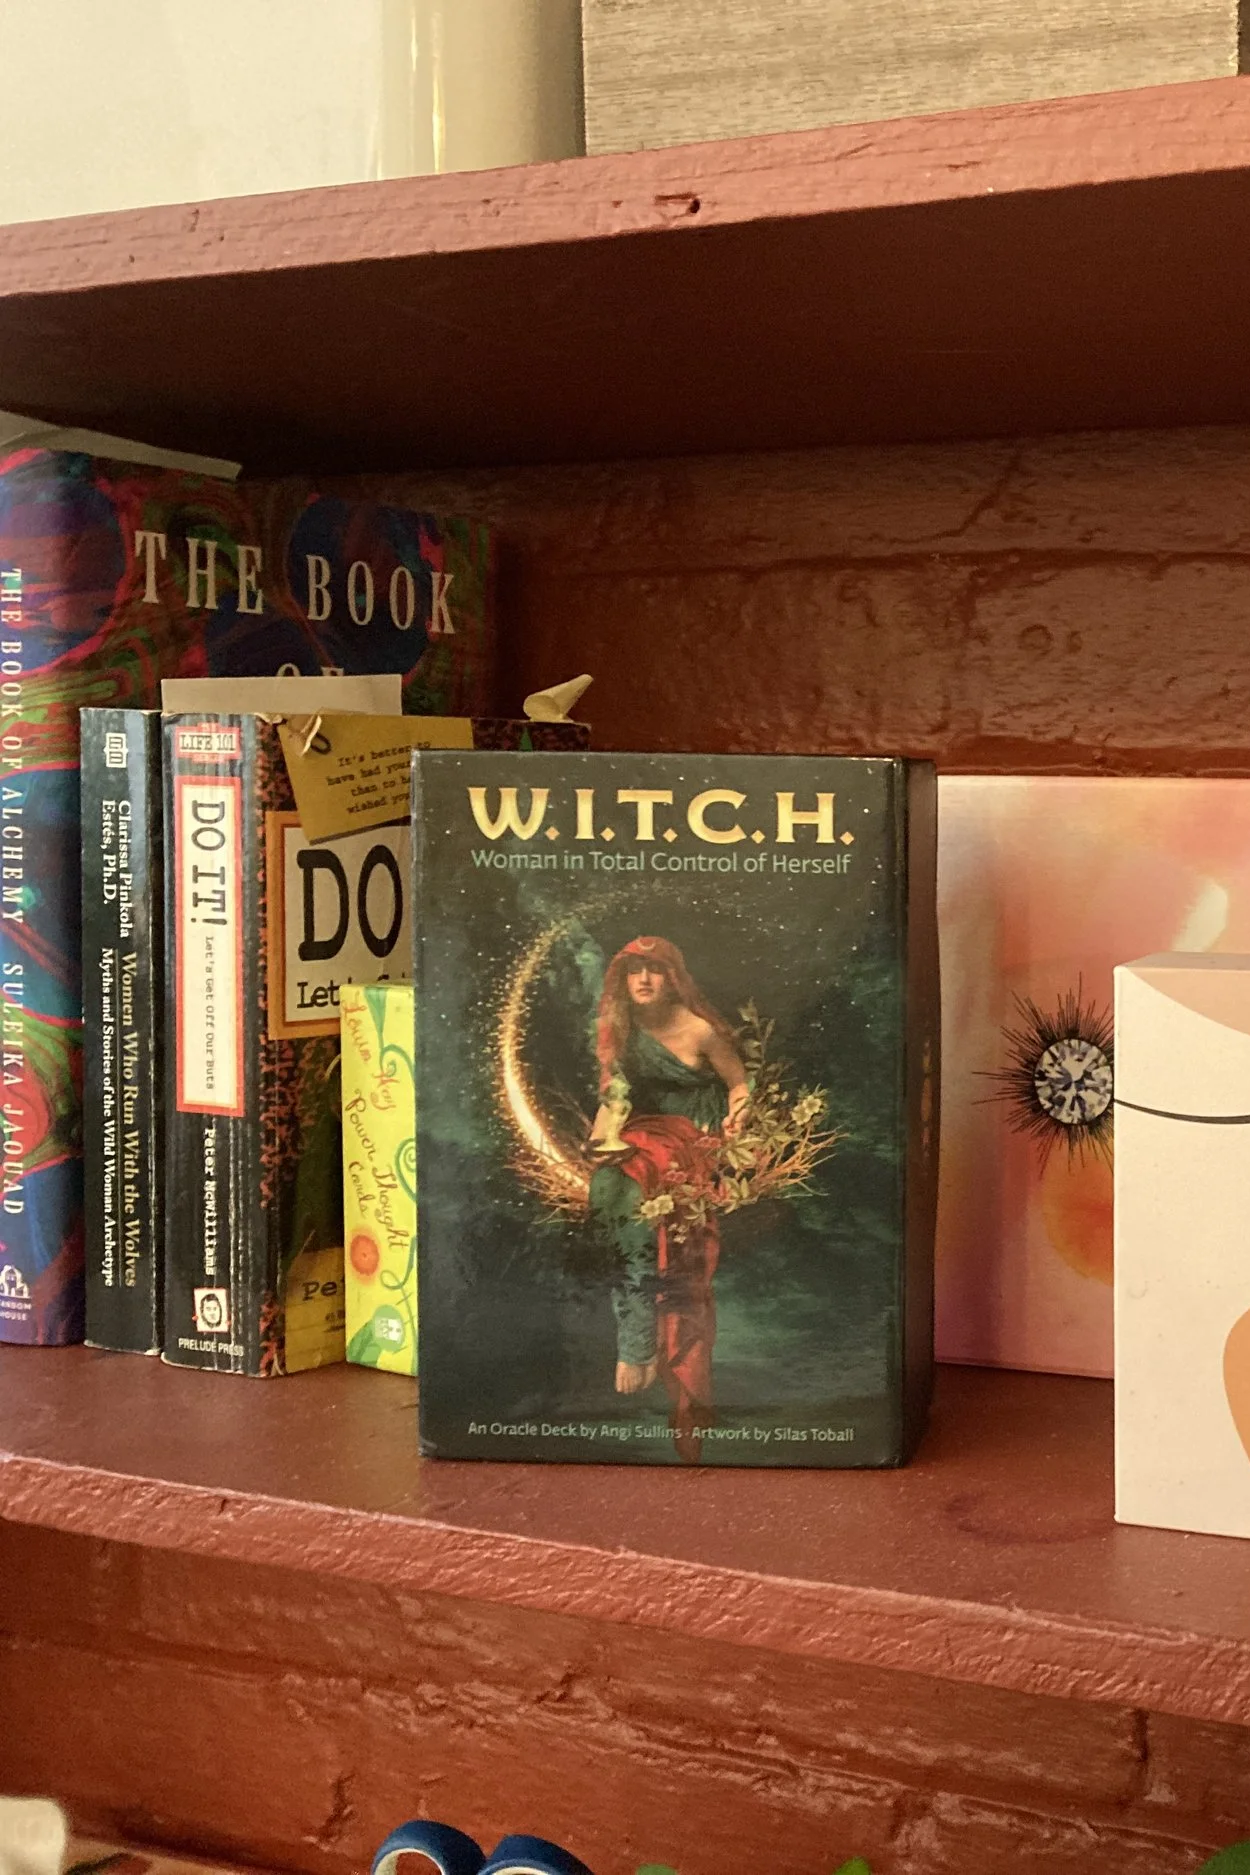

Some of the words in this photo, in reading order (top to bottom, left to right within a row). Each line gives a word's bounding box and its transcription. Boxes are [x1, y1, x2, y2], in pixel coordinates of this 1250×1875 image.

[1, 568, 22, 622] THE
[135, 530, 263, 615] THE
[305, 554, 456, 634] BOOK
[1, 640, 22, 717] BOOK
[1, 736, 22, 769] OF
[180, 734, 212, 750] LIFE
[217, 734, 236, 751] 101
[337, 755, 365, 767] It's
[370, 745, 411, 760] better
[326, 774, 355, 785] have
[360, 765, 381, 778] had
[351, 784, 377, 796] than
[383, 780, 395, 789] to
[100, 800, 116, 849] Estés,
[191, 799, 226, 851] DO
[347, 796, 388, 813] wished
[467, 786, 855, 845] W.I.T.C.H.
[1, 787, 24, 923] ALCHEMY
[118, 800, 133, 869] Clarissa
[103, 854, 117, 905] Ph.D.
[471, 849, 559, 870] Woman
[564, 850, 584, 870] in
[589, 850, 645, 871] Total
[651, 852, 737, 872] Control
[744, 852, 767, 873] of
[773, 854, 851, 874] Herself
[119, 872, 134, 938] Pinkola
[191, 865, 227, 926] IT!
[297, 845, 403, 961] DO
[98, 948, 114, 994] Myths
[205, 936, 214, 973] Let's
[102, 995, 114, 1022] and
[122, 952, 137, 1026] Women
[205, 977, 214, 1001] Get
[297, 977, 353, 1009] Let'
[2, 962, 24, 1086] SULEIKA
[206, 1007, 215, 1027] Off
[102, 1025, 114, 1075] Stories
[122, 1031, 138, 1080] Who
[206, 1032, 215, 1058] Our
[103, 1077, 114, 1093] of
[206, 1060, 215, 1090] Buts
[103, 1094, 114, 1117] the
[123, 1085, 138, 1125] Run
[3, 1102, 25, 1214] JAOUAD
[104, 1119, 116, 1156] Wild
[124, 1129, 140, 1180] With
[204, 1128, 216, 1175] Peter
[104, 1156, 116, 1215] Woman
[345, 1089, 376, 1162] Power
[372, 1164, 410, 1249] Thought
[349, 1161, 376, 1219] Cards
[124, 1184, 139, 1214] the
[101, 1216, 116, 1287] Archetype
[124, 1219, 140, 1287] Wolves
[204, 1181, 216, 1276] McWilliams
[178, 1337, 217, 1353] PRELUDE
[218, 1342, 244, 1357] PRESS
[468, 1422, 487, 1435] An
[490, 1422, 538, 1436] Oracle
[541, 1422, 577, 1437] Deck
[580, 1423, 597, 1440] by
[600, 1424, 631, 1441] Angi
[635, 1423, 682, 1439] Sullins
[691, 1426, 751, 1441] Artwork
[753, 1427, 770, 1443] by
[774, 1427, 807, 1441] Silas
